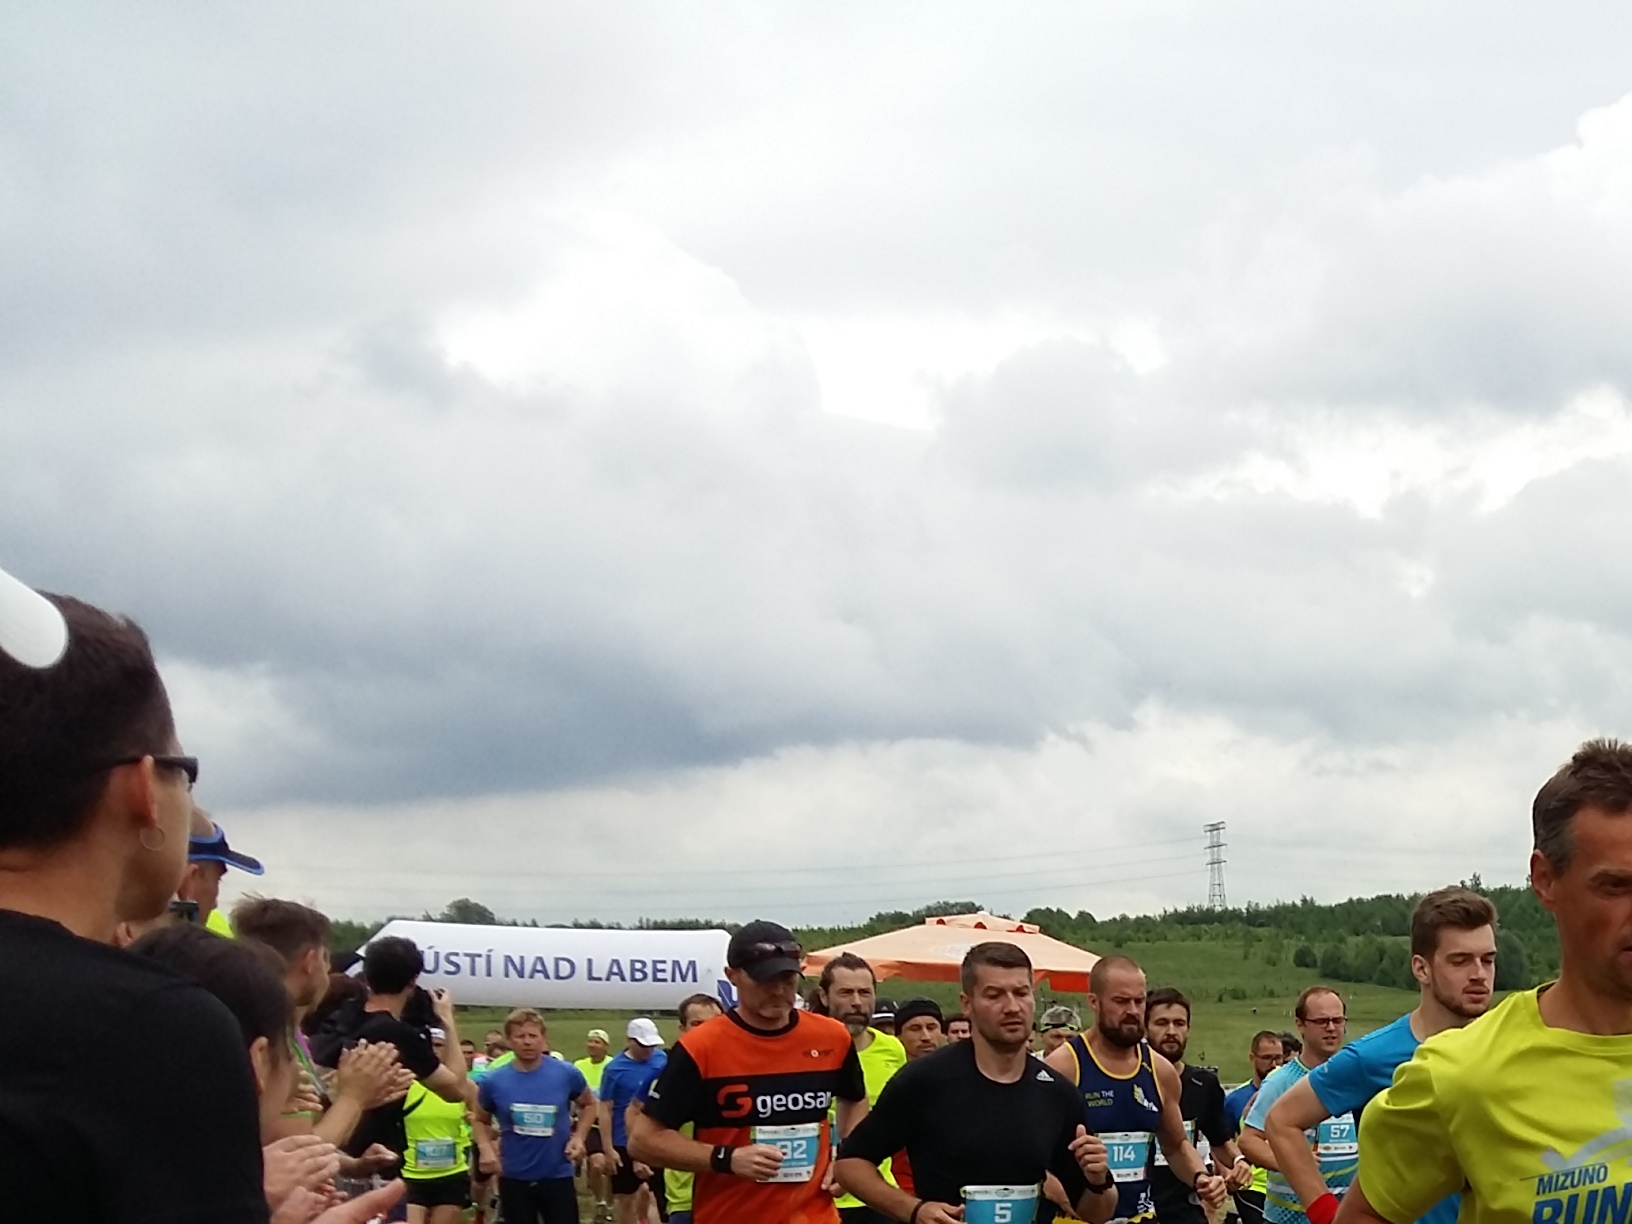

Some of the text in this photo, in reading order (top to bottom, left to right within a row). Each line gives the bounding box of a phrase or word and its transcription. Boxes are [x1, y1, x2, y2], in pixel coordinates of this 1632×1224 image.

[421, 945, 699, 983] ÚSTÍ NAD LABEM
[1088, 1098, 1113, 1107] WORLD
[1101, 1090, 1114, 1098] THE
[1330, 1124, 1350, 1138] 57
[1112, 1145, 1136, 1162] 114
[1536, 1164, 1609, 1196] MIZUNO
[994, 1202, 1012, 1224] 5
